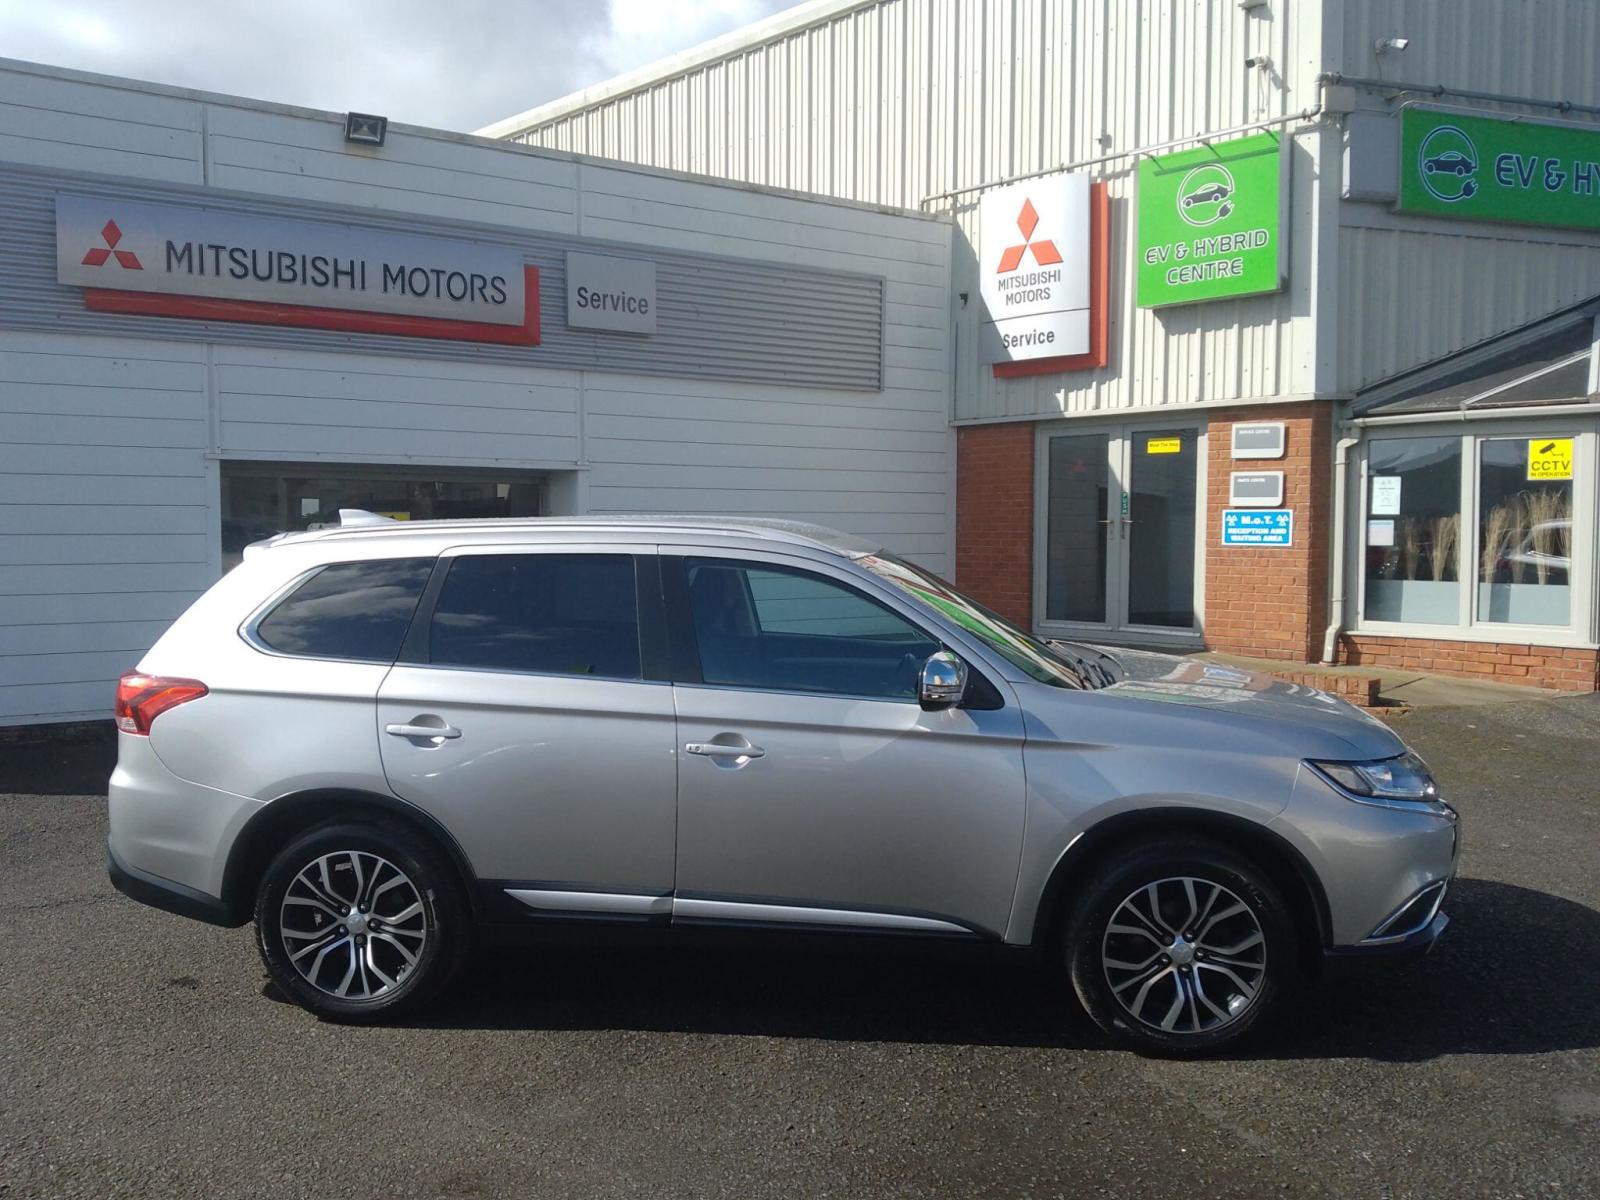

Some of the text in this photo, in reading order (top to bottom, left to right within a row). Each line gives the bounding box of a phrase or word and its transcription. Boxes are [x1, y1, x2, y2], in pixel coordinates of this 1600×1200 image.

[1495, 152, 1538, 189] EV
[1544, 157, 1567, 192] &
[1145, 228, 1269, 265] EV & HYBRID
[166, 239, 507, 305] MITSUBISHI MOTORS
[998, 268, 1061, 292] MITSUBISHI
[1166, 257, 1243, 286] CENTRE
[576, 286, 650, 316] Service
[1005, 287, 1051, 306] MOTORS
[1002, 327, 1055, 349] Service
[1531, 460, 1571, 472] CCTV
